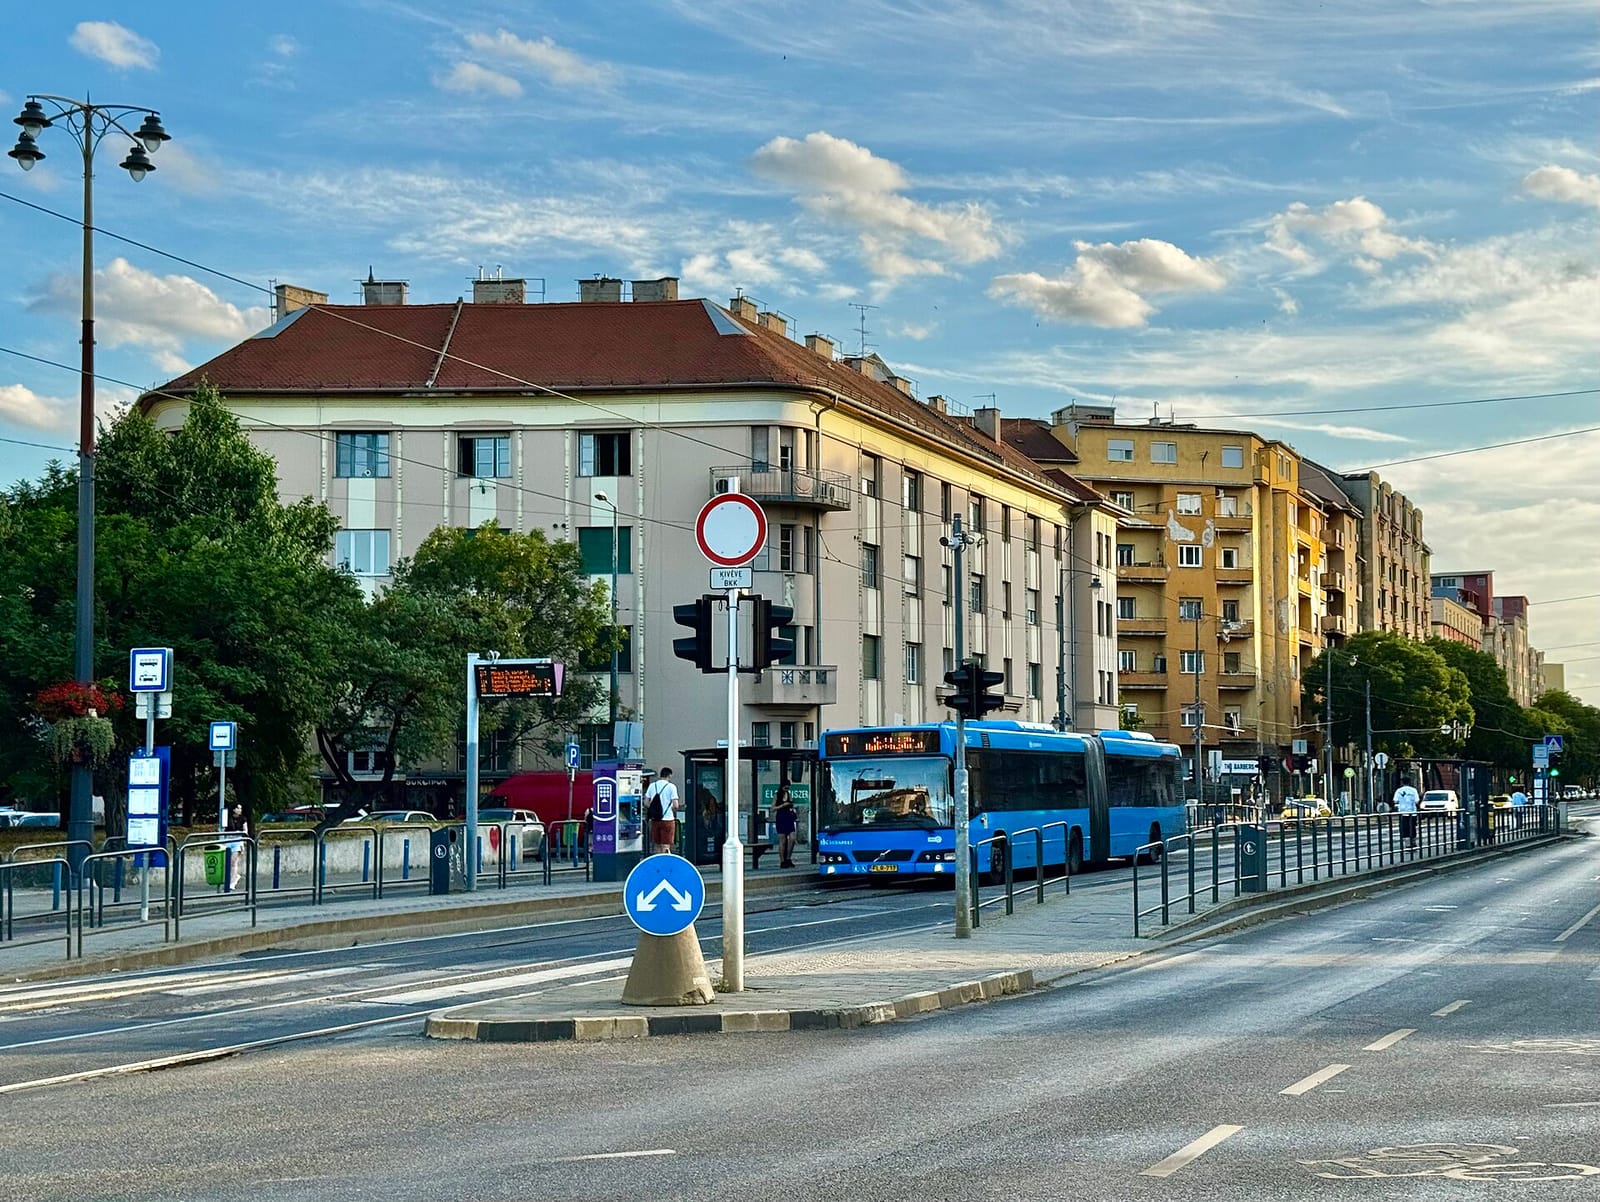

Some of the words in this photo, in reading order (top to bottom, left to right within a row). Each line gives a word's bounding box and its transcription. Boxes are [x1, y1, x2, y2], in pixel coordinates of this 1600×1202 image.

[720, 569, 742, 578] KIVÉVE
[724, 579, 738, 587] BKK
[570, 748, 577, 765] P
[765, 787, 809, 799] ÉLISZER
